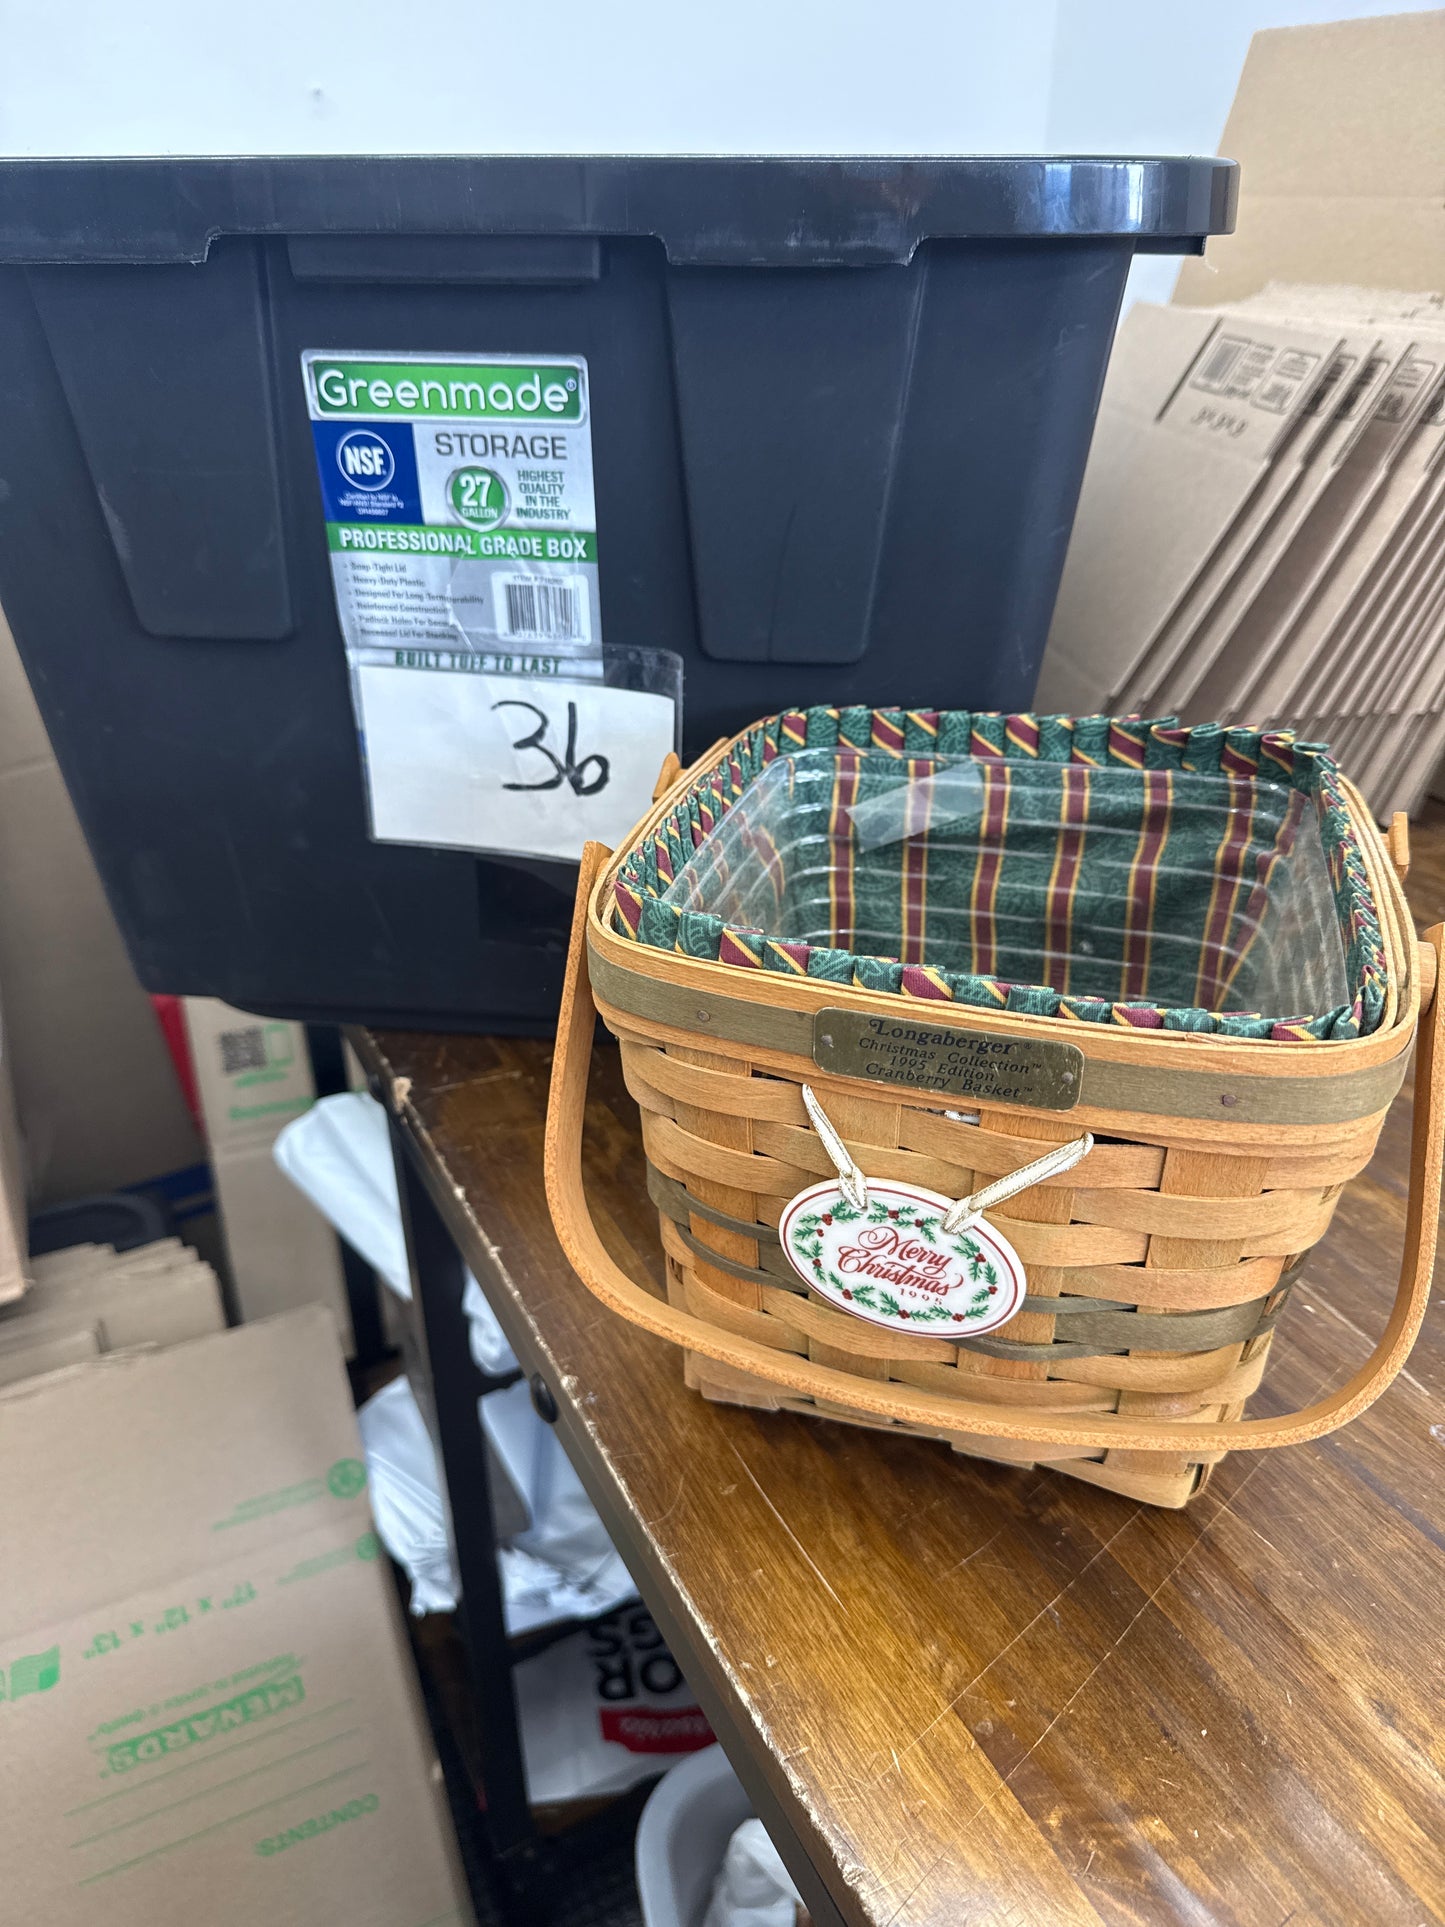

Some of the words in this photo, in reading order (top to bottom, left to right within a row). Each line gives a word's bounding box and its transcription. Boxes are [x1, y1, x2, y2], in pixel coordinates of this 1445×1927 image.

[435, 432, 568, 461] STORAGE
[344, 446, 385, 476] NSF
[517, 470, 564, 483] HIGHEST
[518, 482, 565, 496] QUALITY
[460, 475, 492, 508] 27
[526, 495, 539, 507] IN
[542, 496, 561, 508] THE
[461, 507, 499, 520] GALLON
[516, 507, 571, 521] INDUSTRY
[339, 528, 477, 556] PROFESSIONAL
[480, 536, 543, 558] GRADE
[547, 538, 588, 559] BOX
[398, 577, 426, 588] Plastic
[395, 650, 441, 669] BUILT
[449, 653, 488, 671] TUFF
[496, 655, 513, 672] TO
[521, 656, 562, 675] LAST
[491, 700, 610, 796] 36
[859, 1037, 936, 1061] Christmas
[865, 1062, 951, 1090] Cranberry
[890, 1055, 927, 1071] 1995
[937, 1061, 995, 1082] Edition
[858, 1226, 953, 1280] Merry
[838, 1245, 964, 1297] Christmas
[899, 1287, 943, 1306] 1995
[107, 1678, 303, 1774] MENARDS
[254, 1793, 380, 1857] CONTENTS
